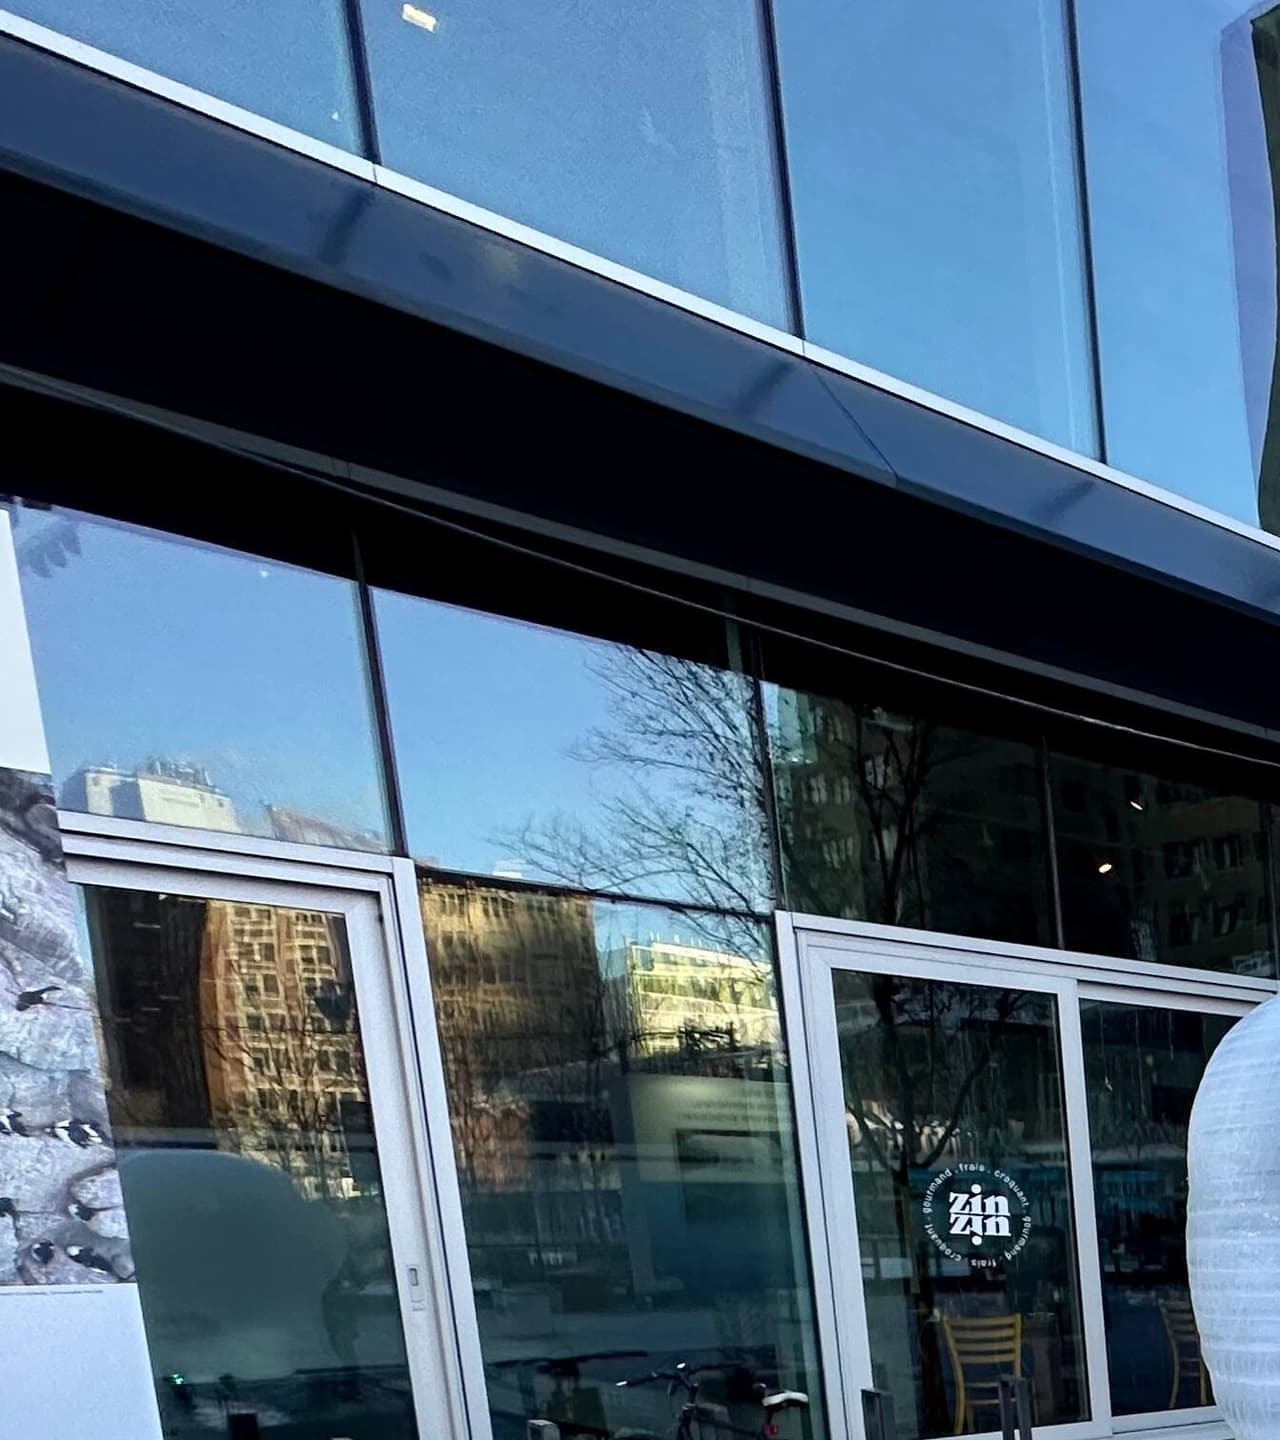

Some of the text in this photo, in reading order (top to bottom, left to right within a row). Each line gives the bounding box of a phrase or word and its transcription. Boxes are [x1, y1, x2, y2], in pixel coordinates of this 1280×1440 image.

[959, 1162, 985, 1172] frais
[922, 1168, 953, 1214] gourmand
[994, 1169, 1030, 1207] croquant
[924, 1223, 962, 1262] croquant
